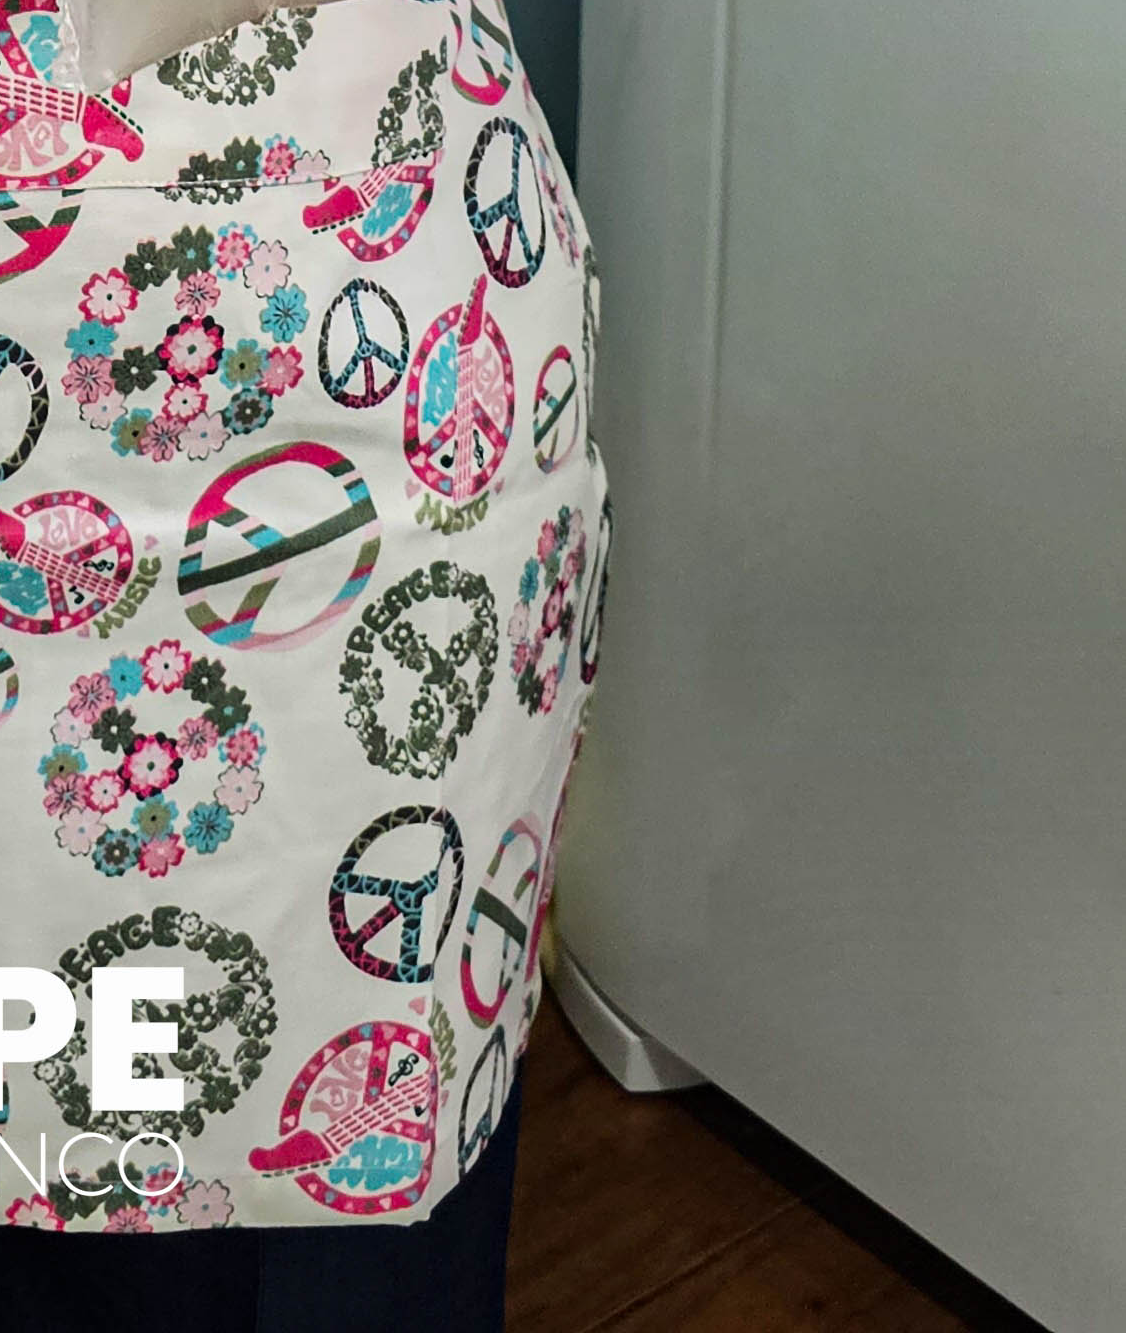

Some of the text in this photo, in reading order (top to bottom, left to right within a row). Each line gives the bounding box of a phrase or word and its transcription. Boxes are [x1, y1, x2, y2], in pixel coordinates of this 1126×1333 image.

[92, 555, 163, 640] MUSIC
[346, 560, 452, 654] PEACE
[54, 904, 182, 988] EACE
